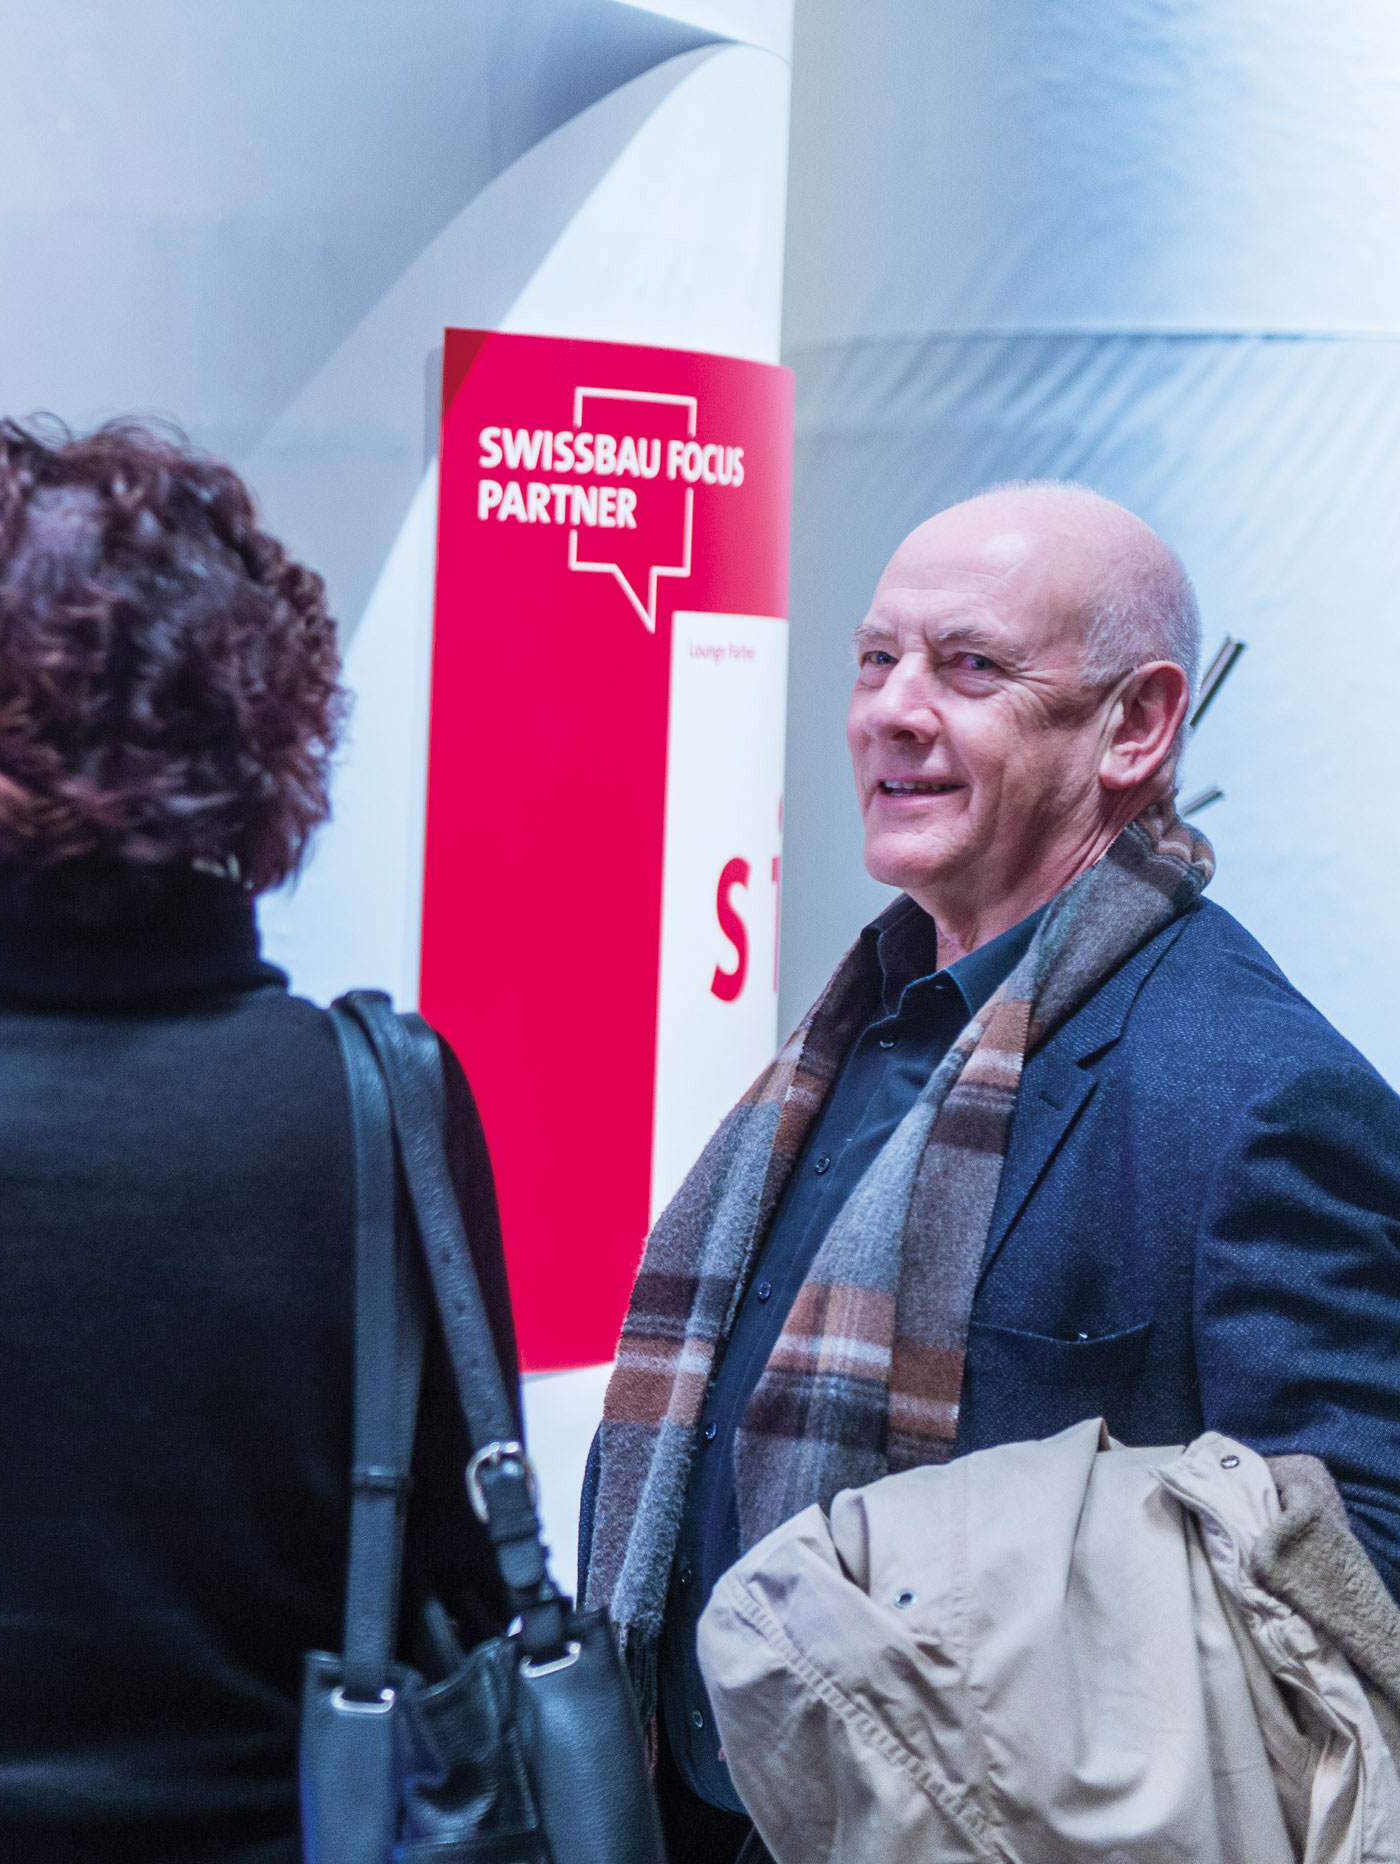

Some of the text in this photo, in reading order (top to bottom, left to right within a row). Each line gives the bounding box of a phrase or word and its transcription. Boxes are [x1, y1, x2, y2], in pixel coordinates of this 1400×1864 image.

[478, 426, 745, 488] SWISSBAU FOCUS
[477, 479, 638, 530] PARTNER
